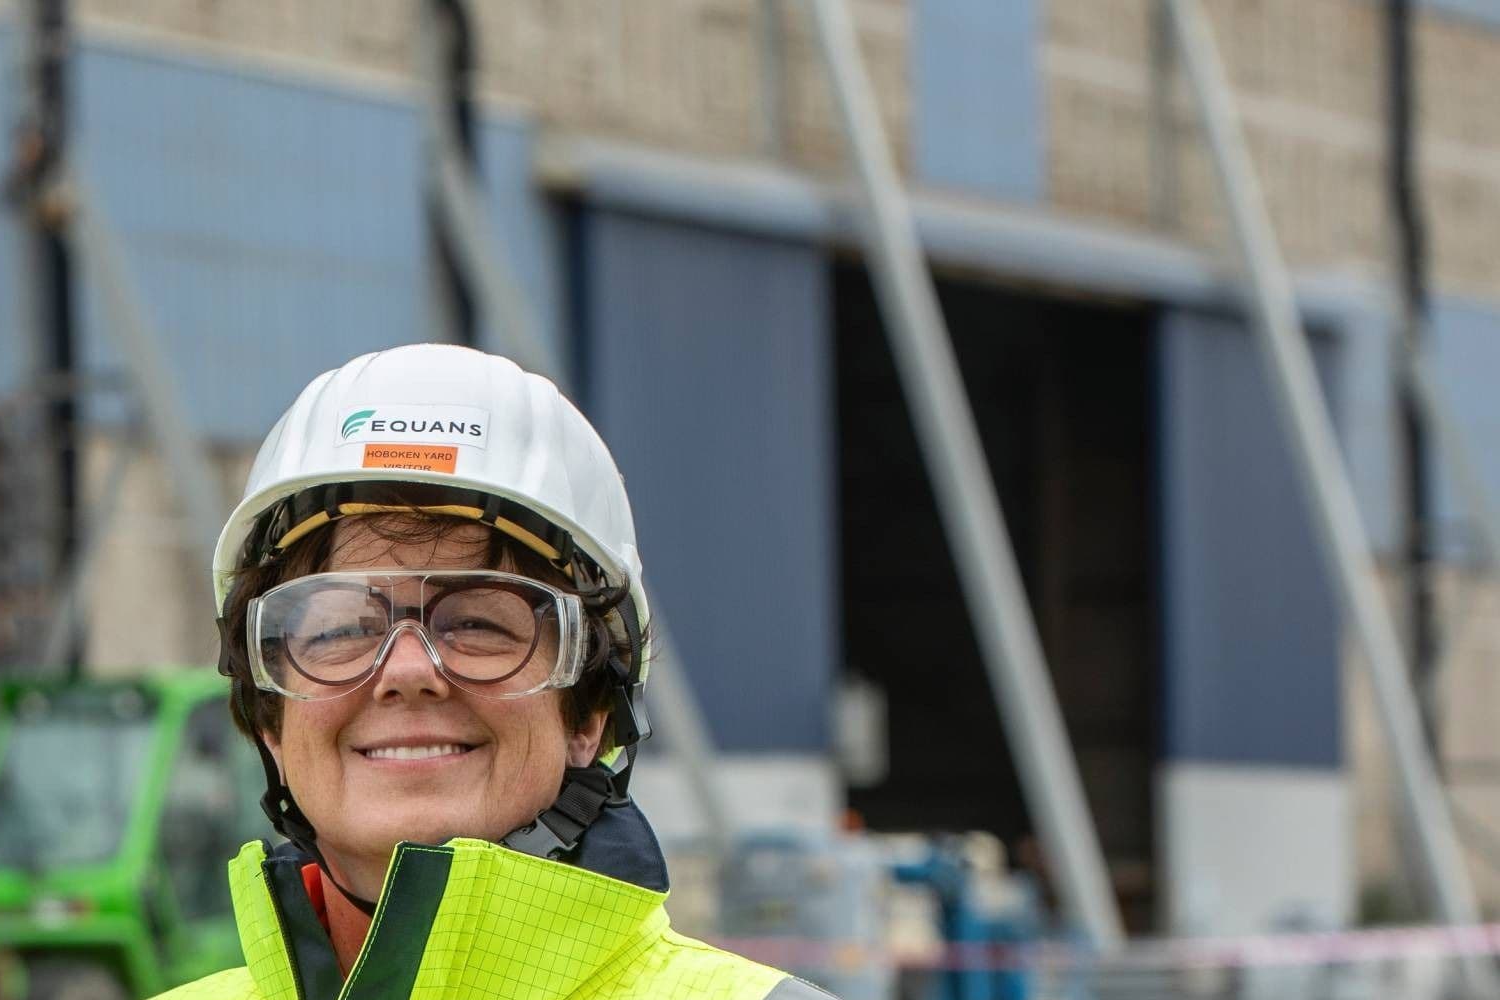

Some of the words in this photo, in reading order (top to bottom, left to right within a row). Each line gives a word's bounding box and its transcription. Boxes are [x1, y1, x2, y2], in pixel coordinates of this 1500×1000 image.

[371, 420, 482, 436] EQUANS
[367, 451, 420, 459] HOBOKEN
[424, 452, 452, 461] YARD
